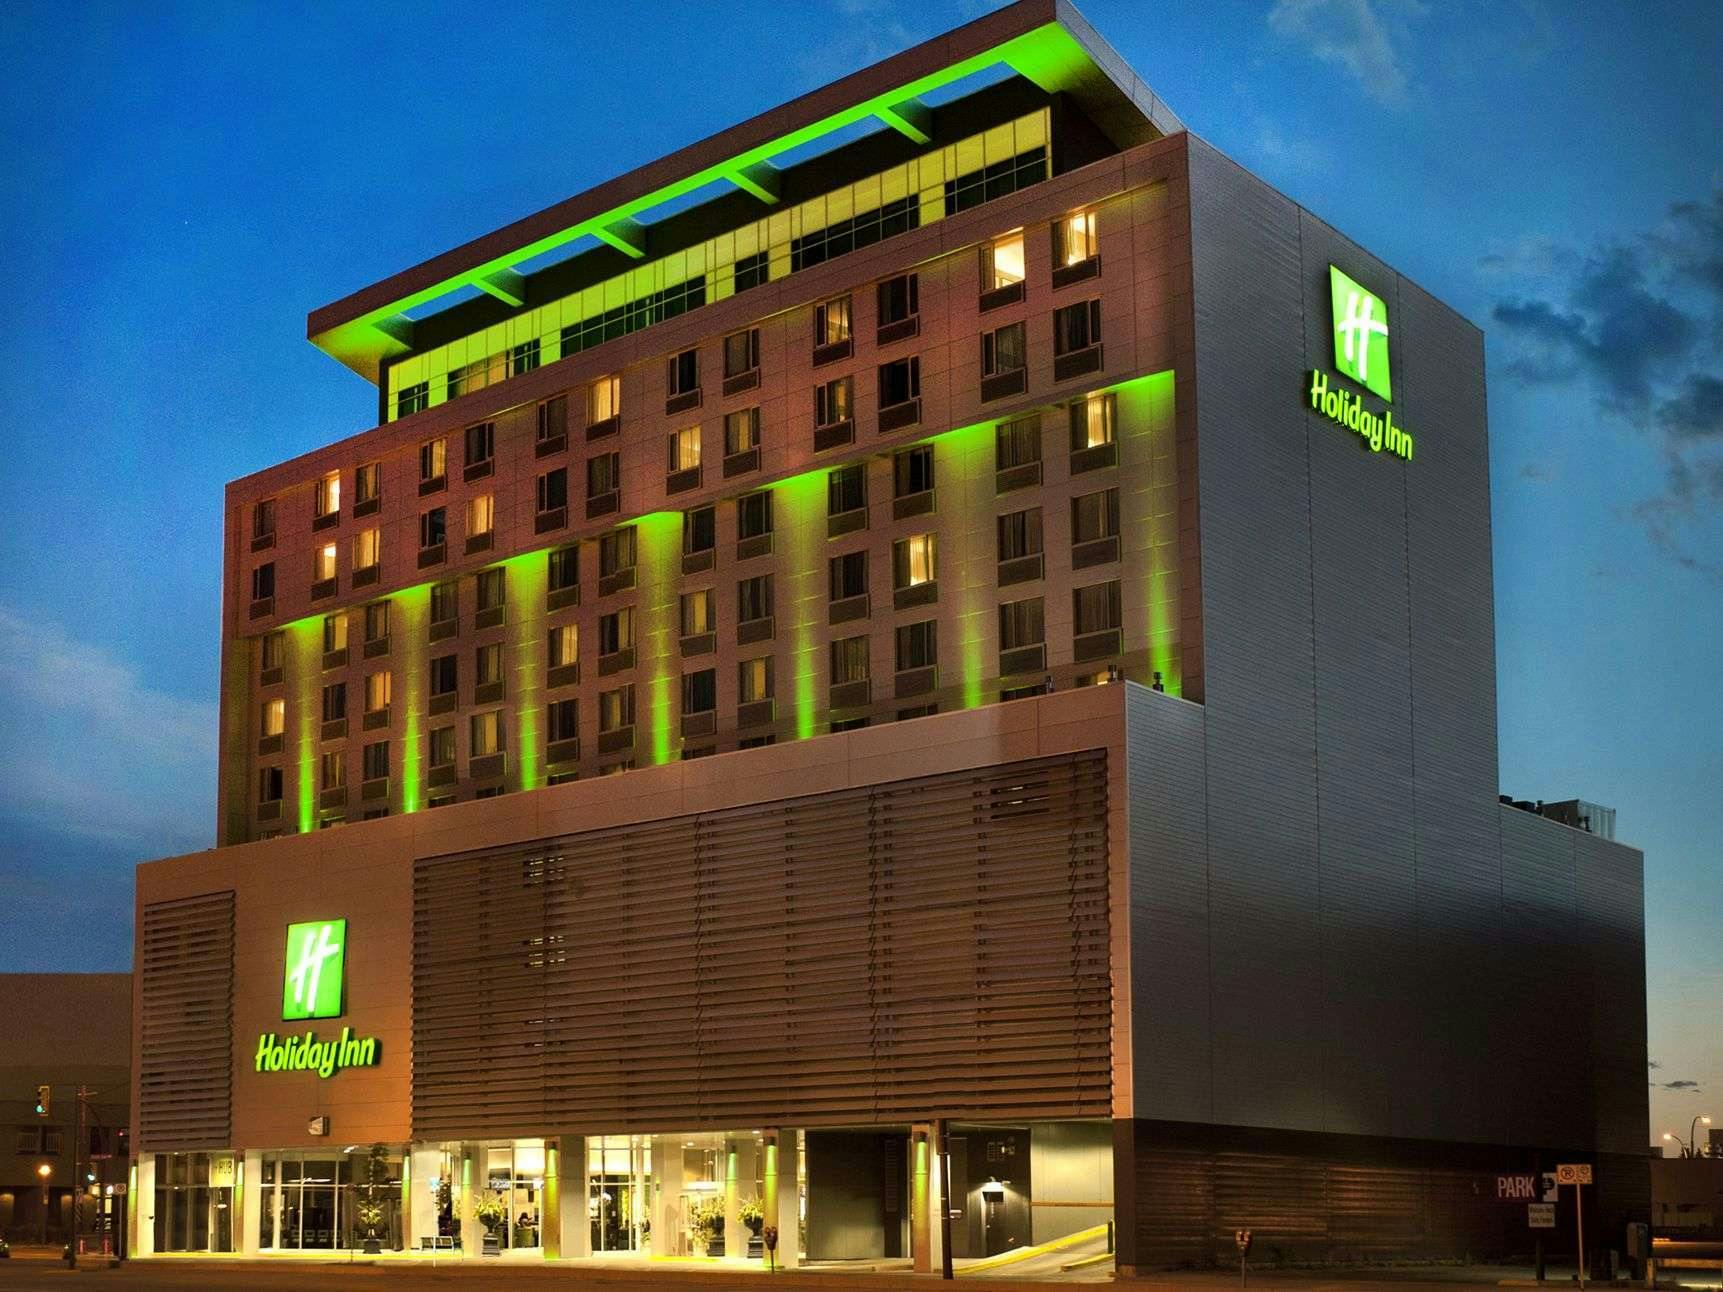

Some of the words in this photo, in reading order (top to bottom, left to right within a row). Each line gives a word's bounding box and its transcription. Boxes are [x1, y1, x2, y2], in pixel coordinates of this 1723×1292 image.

[1311, 368, 1383, 452] Holiday
[1384, 410, 1413, 461] Inn
[255, 1031, 338, 1079] Holiday
[338, 1026, 376, 1068] Inn
[1497, 1175, 1536, 1198] PARK
